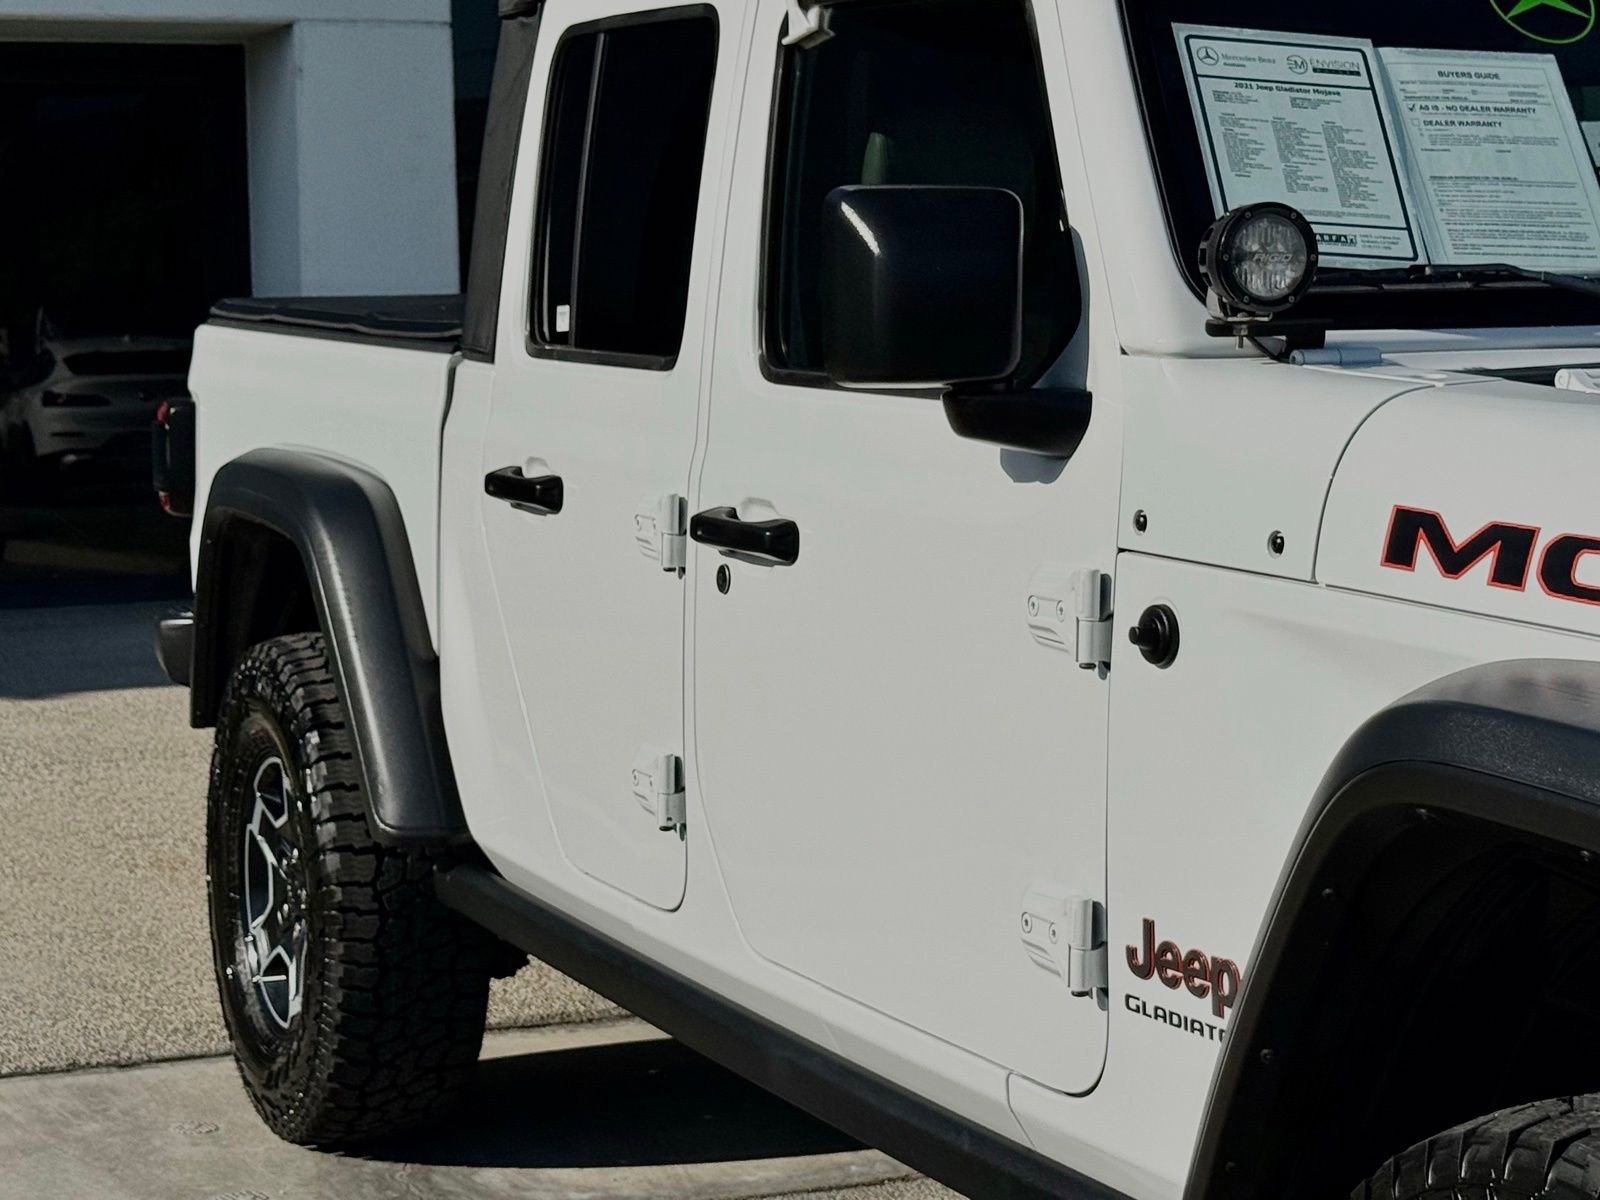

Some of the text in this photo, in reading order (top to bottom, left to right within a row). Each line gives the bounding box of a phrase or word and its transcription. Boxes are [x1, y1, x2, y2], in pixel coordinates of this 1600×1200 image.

[1310, 58, 1360, 70] ENVISION
[1437, 70, 1501, 80] BUYERS GUIDE
[1255, 84, 1275, 92] Jeep
[1275, 85, 1311, 95] Gladiator
[1312, 88, 1342, 97] Mojave
[1431, 104, 1440, 112] IS
[1458, 105, 1492, 113] DEALER
[1493, 106, 1536, 114] WARRANTY
[1423, 119, 1502, 128] DEALER WARRANTY
[1252, 252, 1293, 263] RIGID
[1125, 917, 1241, 1019] Jeep
